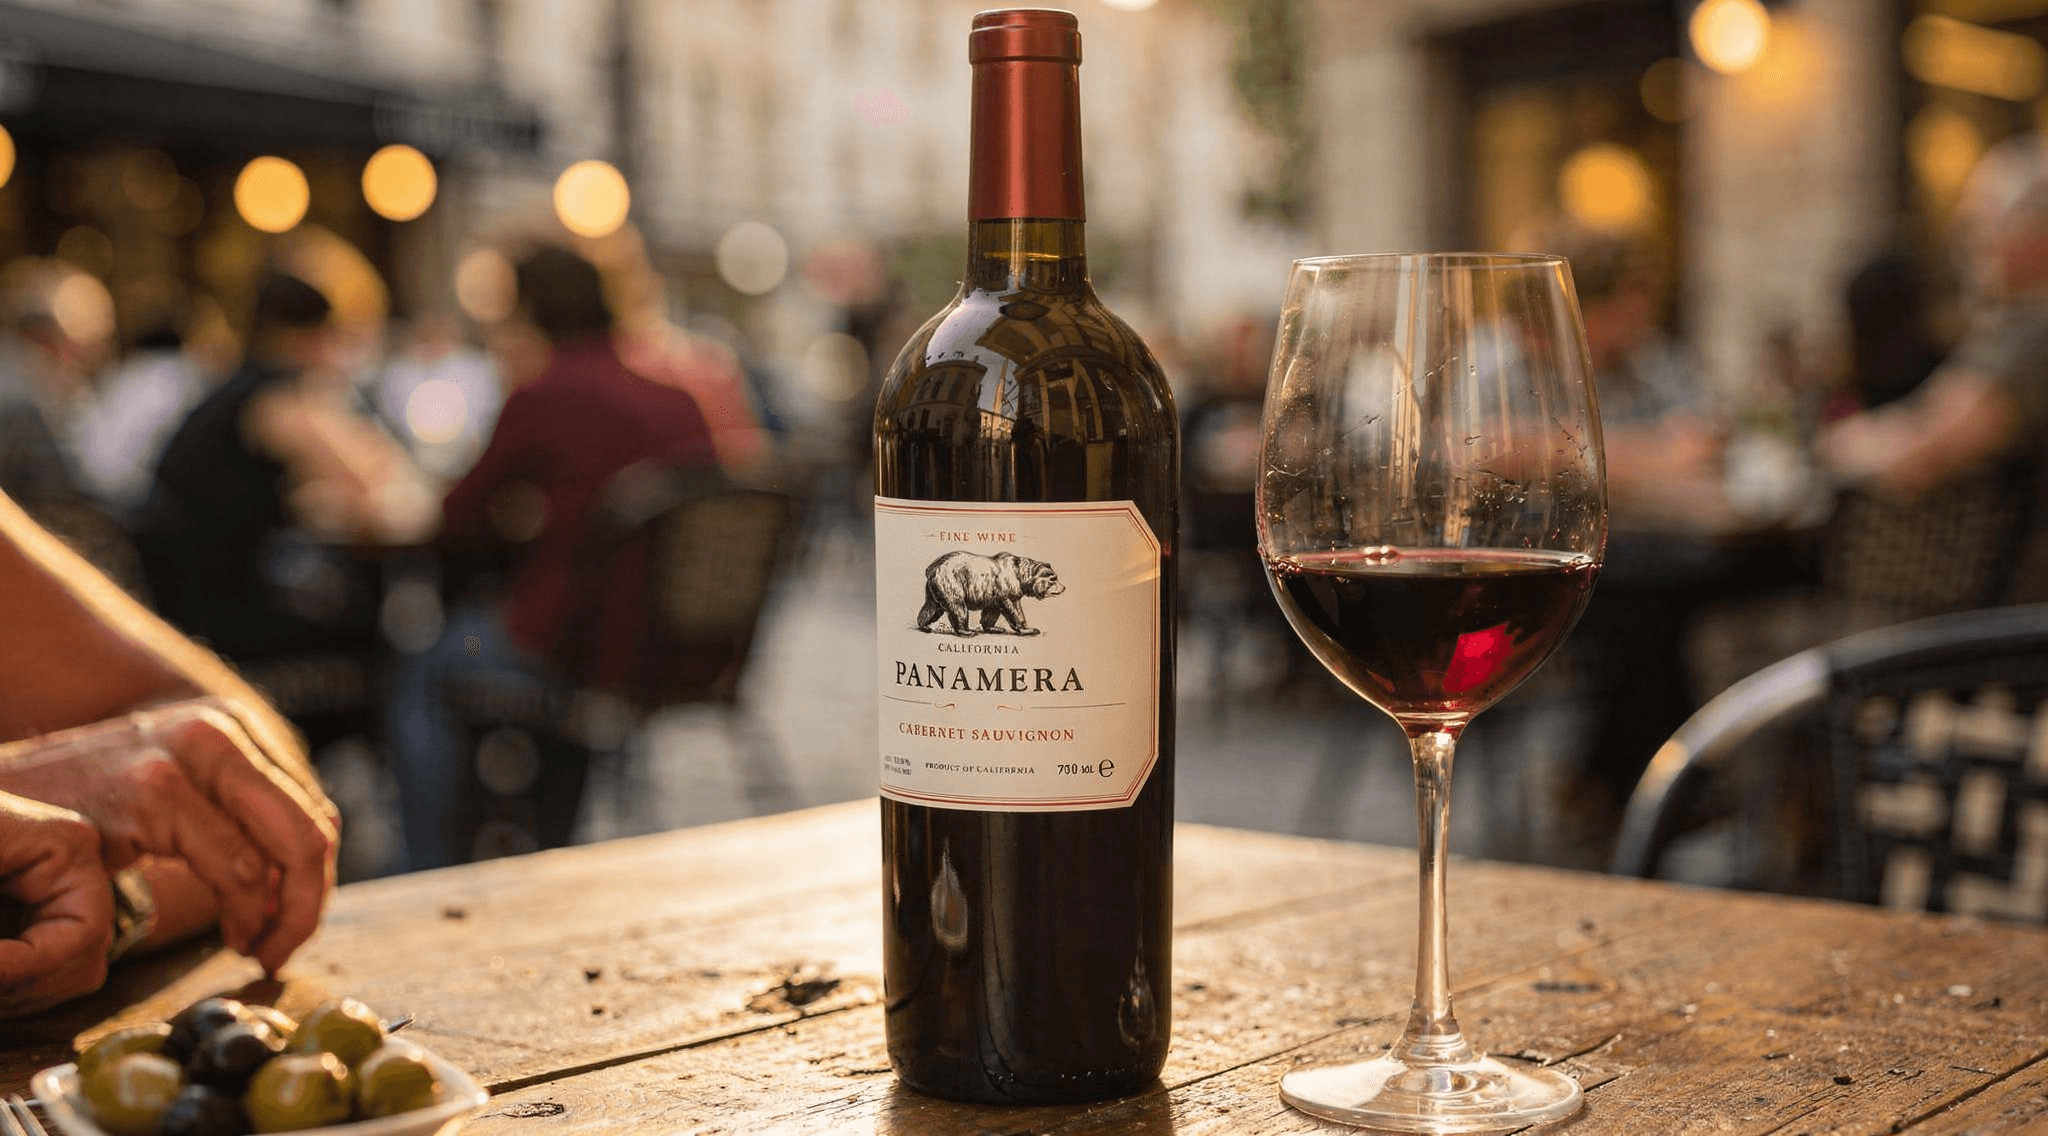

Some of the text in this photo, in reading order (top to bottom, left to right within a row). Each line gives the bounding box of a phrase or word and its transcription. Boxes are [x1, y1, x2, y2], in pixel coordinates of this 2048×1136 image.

[940, 531, 1016, 543] FINE WINE
[937, 642, 1019, 655] CALIFORNIA
[895, 660, 1084, 692] PANAMERA
[898, 722, 1075, 742] CABERNET SAUVIGNON
[962, 763, 974, 773] OF
